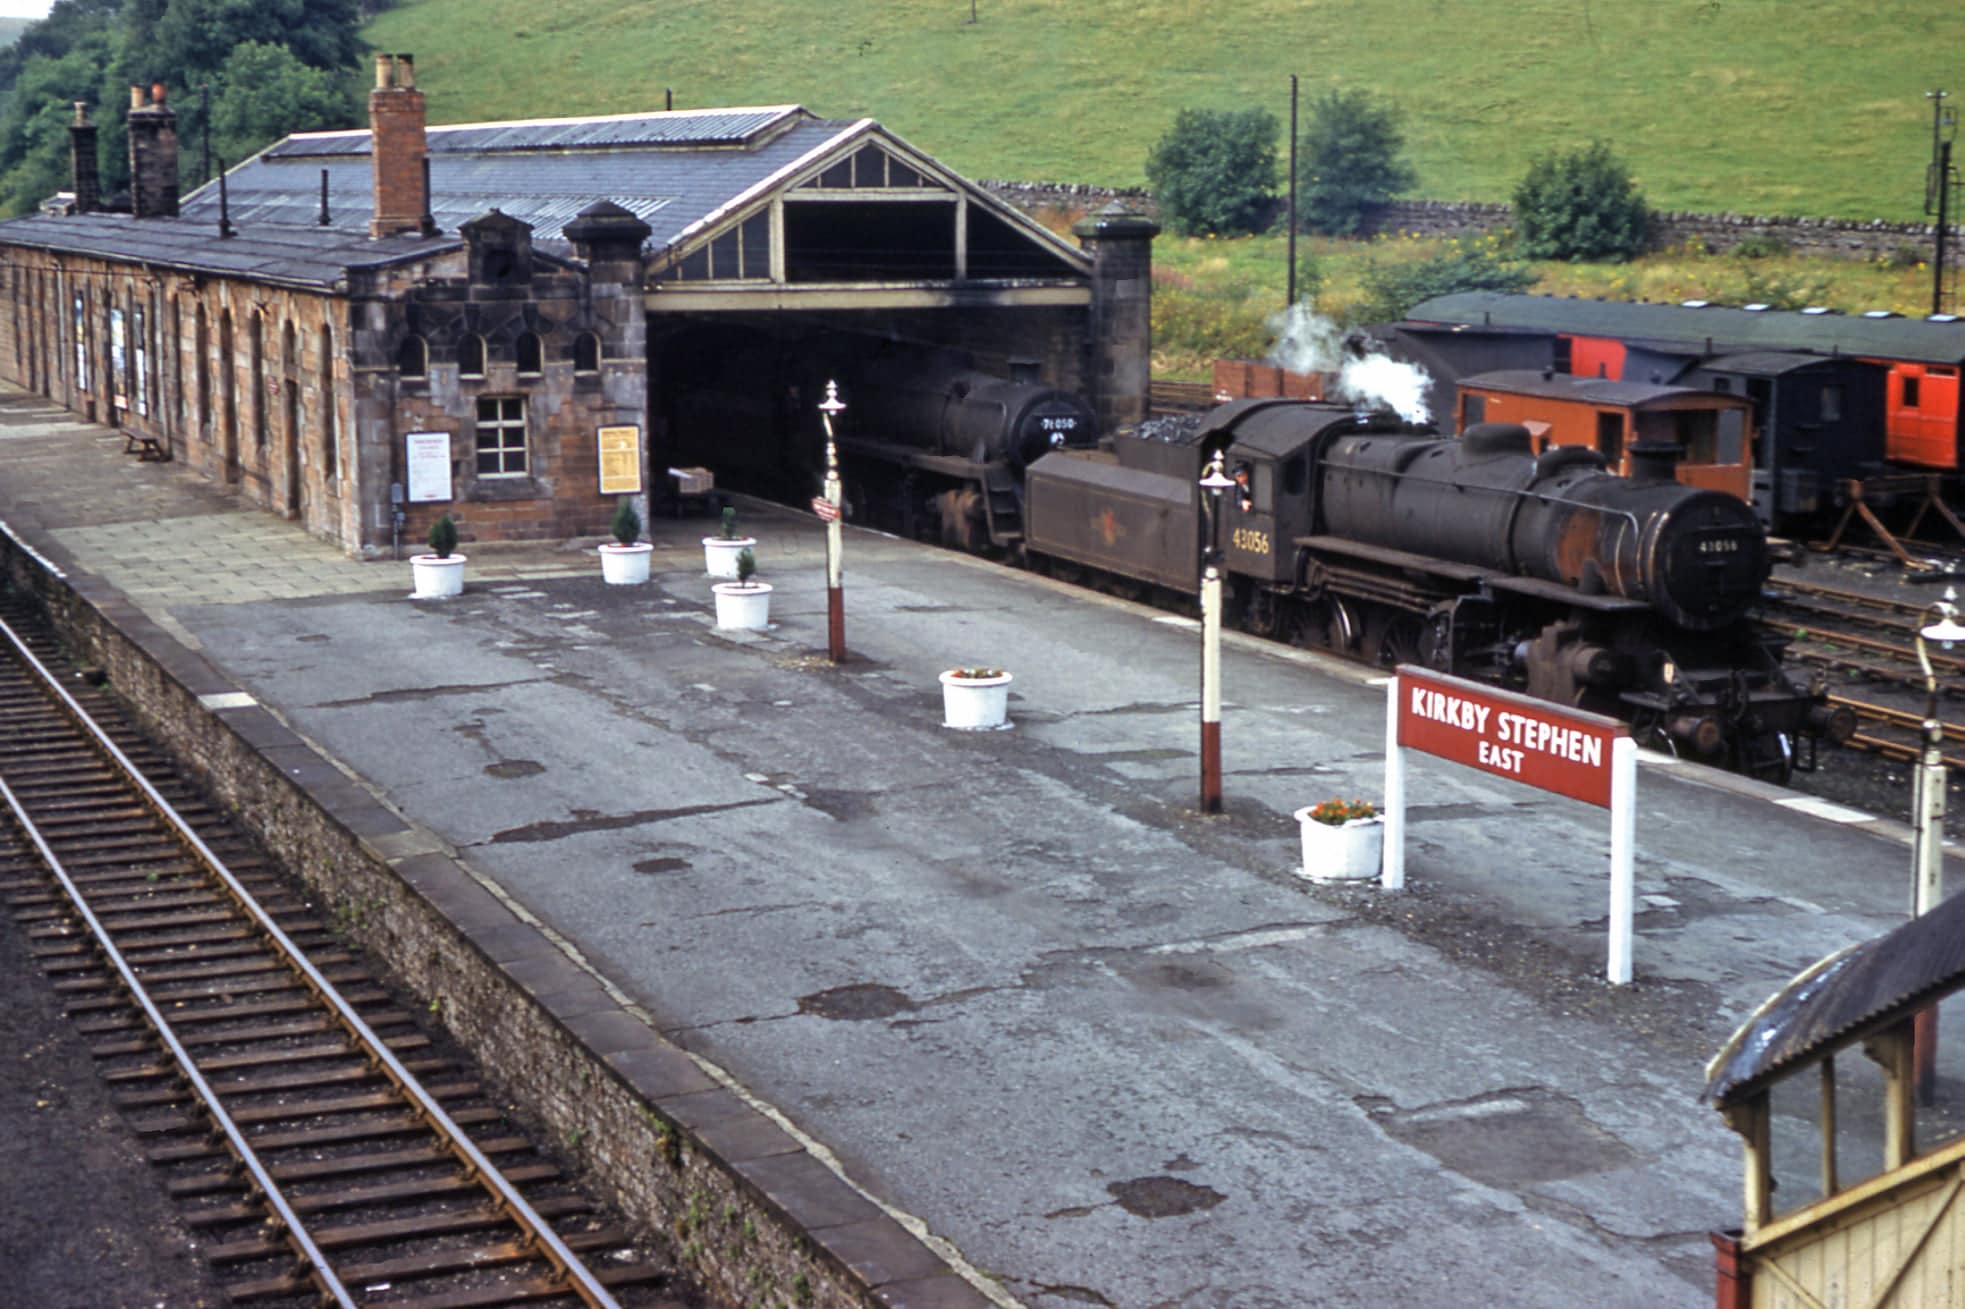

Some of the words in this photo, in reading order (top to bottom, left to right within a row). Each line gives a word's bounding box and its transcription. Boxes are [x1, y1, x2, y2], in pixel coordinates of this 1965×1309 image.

[1232, 527, 1269, 554] 43056
[1411, 687, 1490, 734] KIRKBY
[1497, 711, 1602, 767] STEPHEN
[1478, 741, 1525, 773] EAST
